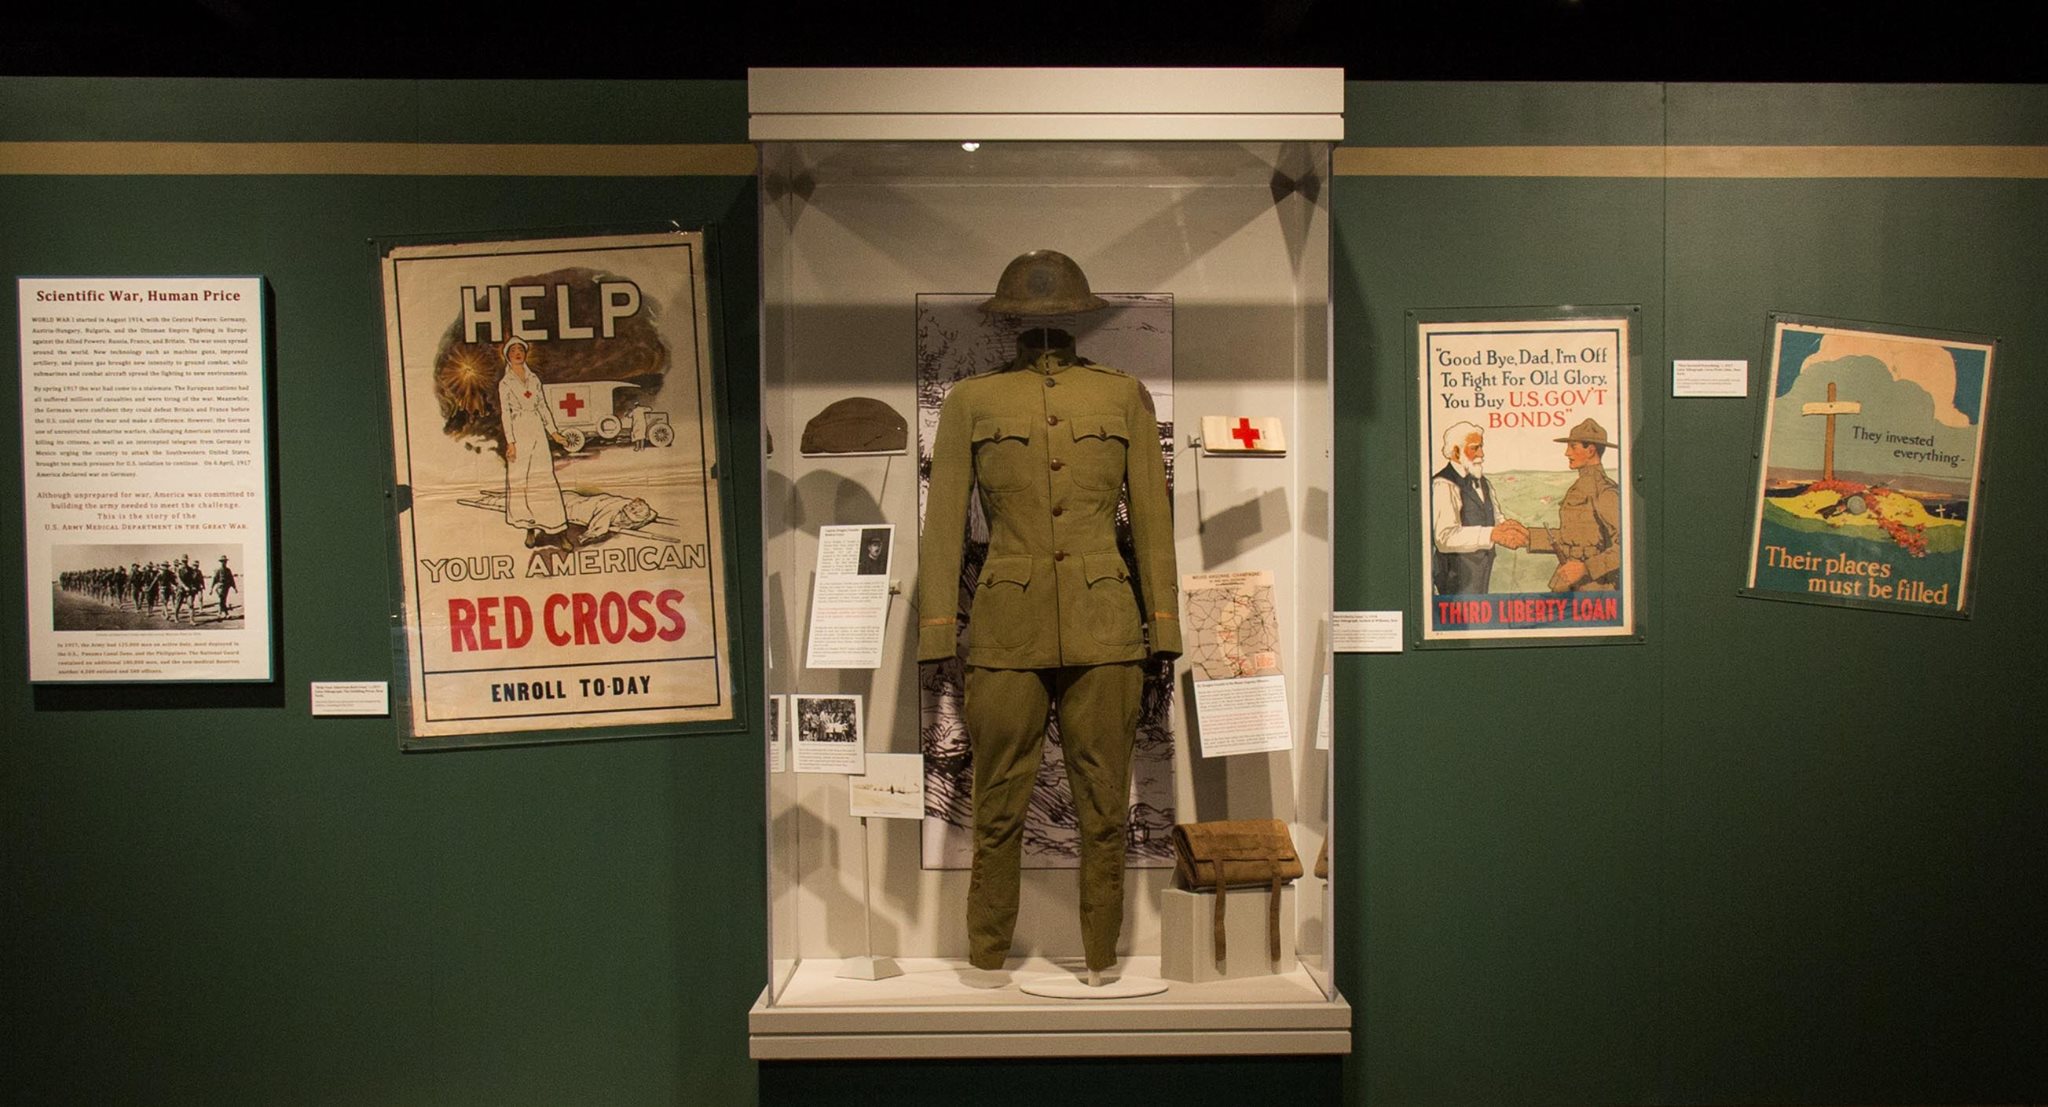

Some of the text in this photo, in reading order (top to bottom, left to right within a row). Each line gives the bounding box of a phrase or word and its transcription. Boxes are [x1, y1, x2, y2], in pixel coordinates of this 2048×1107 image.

[36, 290, 240, 303] Scientific War, Human Price
[461, 280, 642, 344] HELP
[1436, 347, 1482, 367] "Good
[1487, 350, 1518, 369] Bye,
[1556, 348, 1576, 364] I'm
[1580, 347, 1608, 362] Off
[1441, 369, 1608, 391] To Fight For Old Glory.
[1441, 393, 1470, 408] You
[1474, 392, 1505, 410] Buy
[1488, 409, 1572, 428] BONDS"
[1853, 426, 1934, 447] They invested
[421, 543, 705, 583] YOUR AMERICAN
[1765, 545, 1892, 577] Their places
[1808, 578, 1948, 605] must be filled
[448, 589, 686, 653] RED CROSS
[1438, 598, 1617, 624] THIRD LIBERTY LOAN
[492, 681, 568, 703] ENROLL
